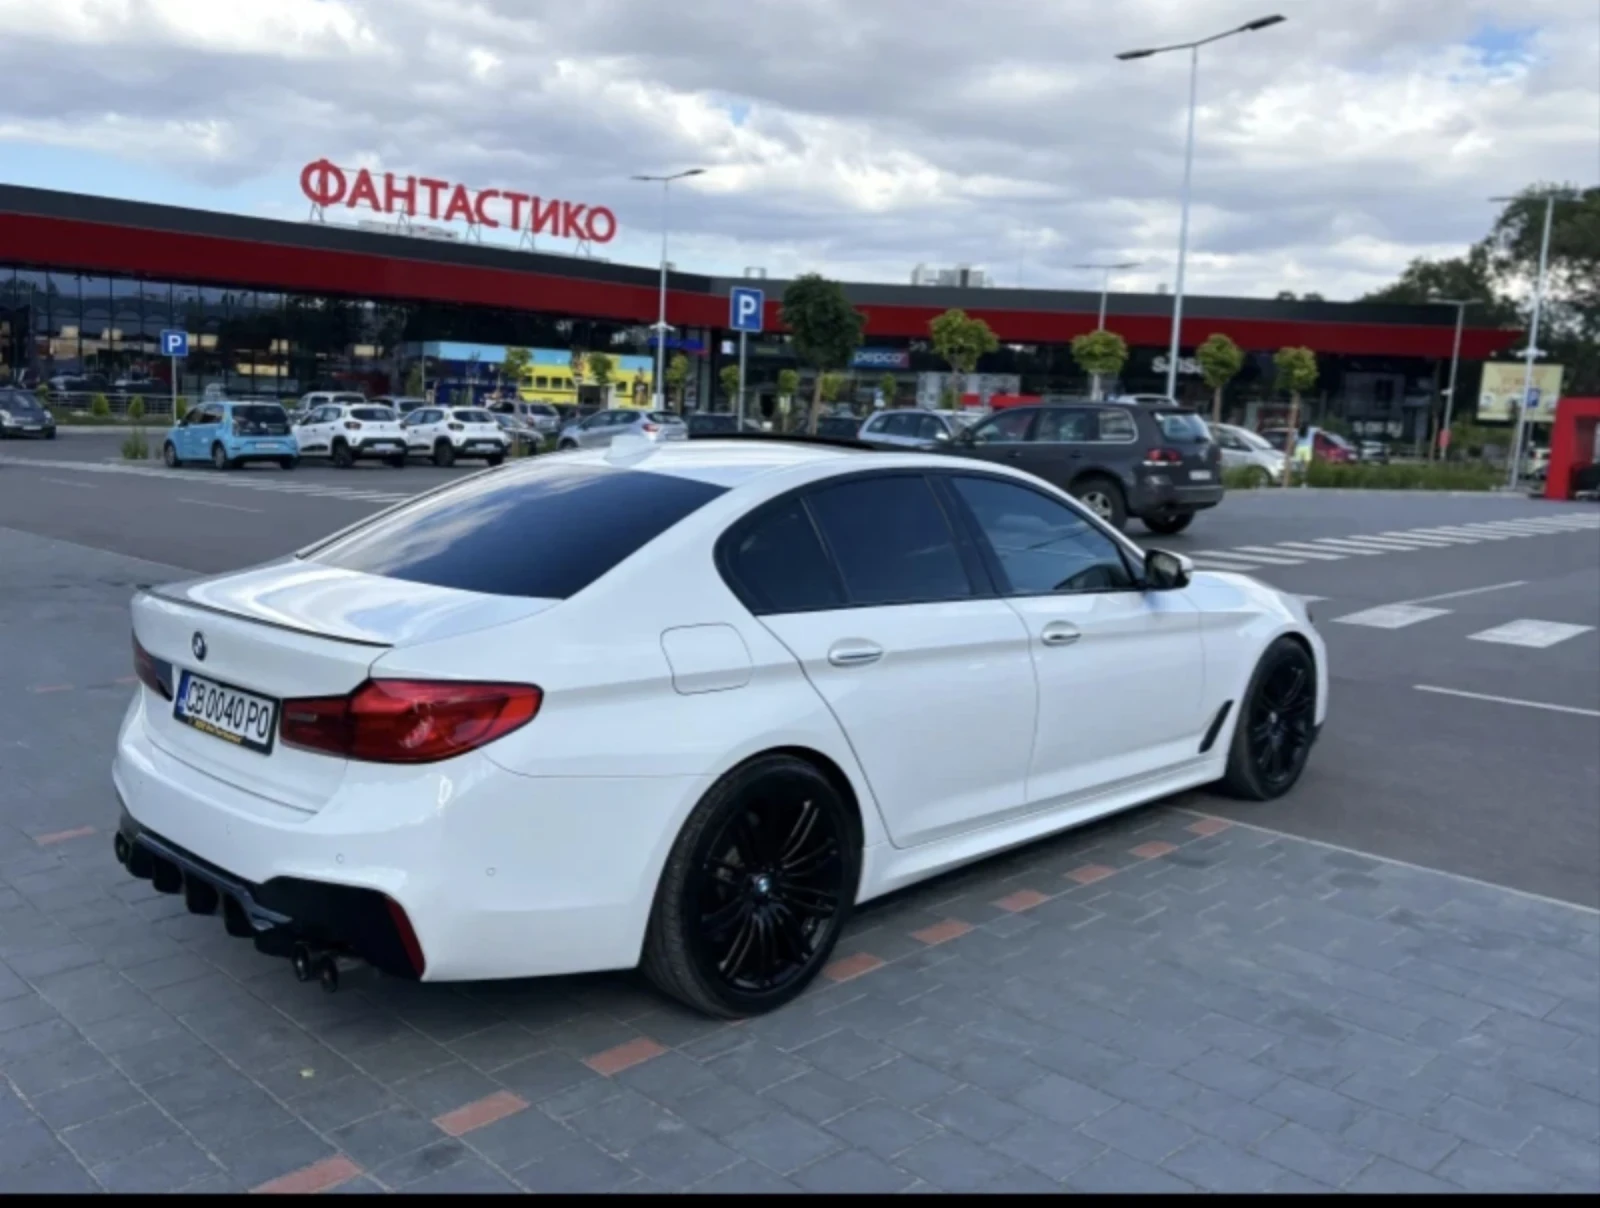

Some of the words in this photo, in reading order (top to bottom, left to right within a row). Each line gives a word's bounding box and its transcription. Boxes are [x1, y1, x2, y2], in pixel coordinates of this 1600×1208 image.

[300, 158, 617, 243] ФАНТАСТИКО
[738, 294, 757, 326] P
[167, 335, 182, 352] P
[853, 350, 903, 364] pepco
[186, 681, 205, 714] CB
[206, 688, 244, 729] 0040
